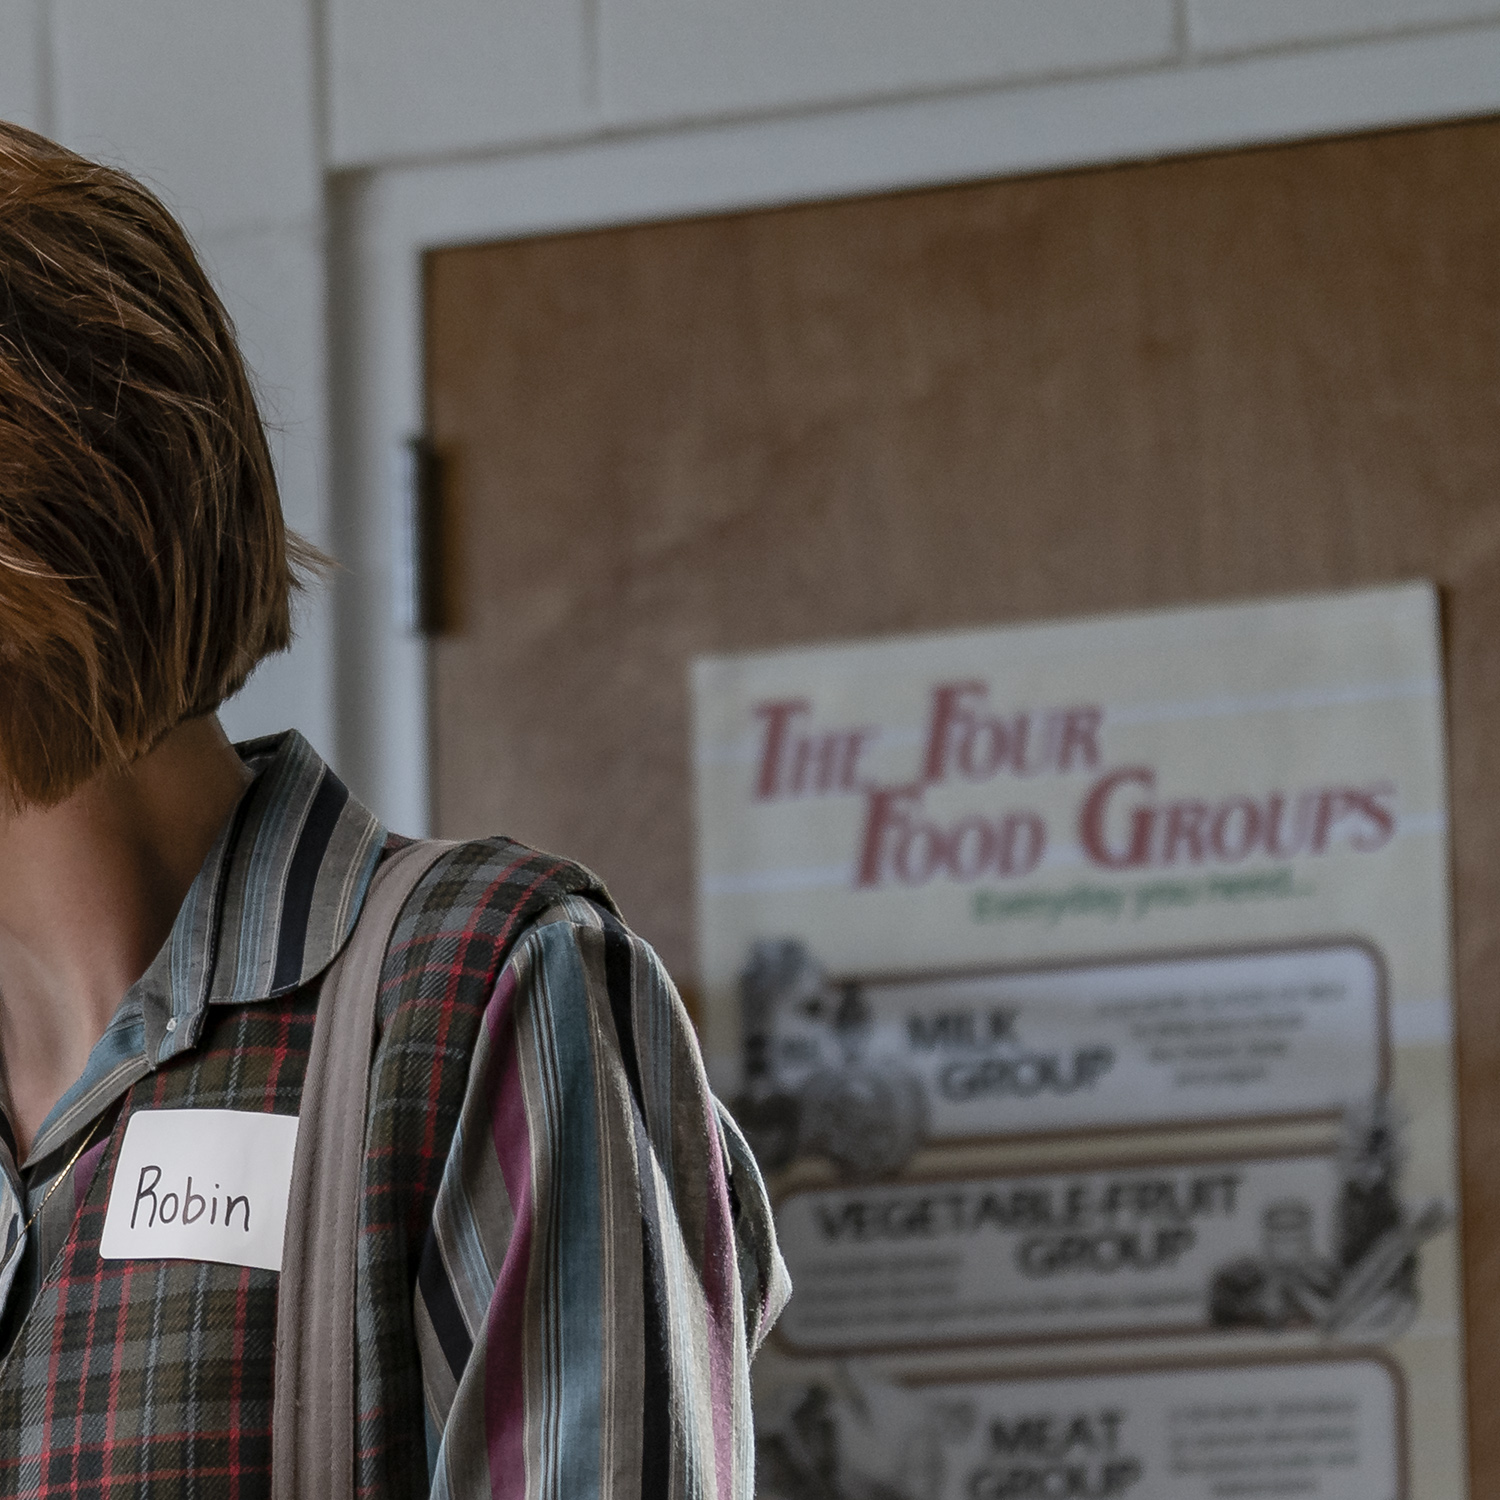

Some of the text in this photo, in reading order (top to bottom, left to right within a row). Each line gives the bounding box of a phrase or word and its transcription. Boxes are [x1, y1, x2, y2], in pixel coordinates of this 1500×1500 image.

[940, 1044, 1116, 1101] GROUP
[131, 1165, 250, 1232] Robin
[1016, 1226, 1200, 1281] GROUP
[990, 1409, 1127, 1457] MEAT
